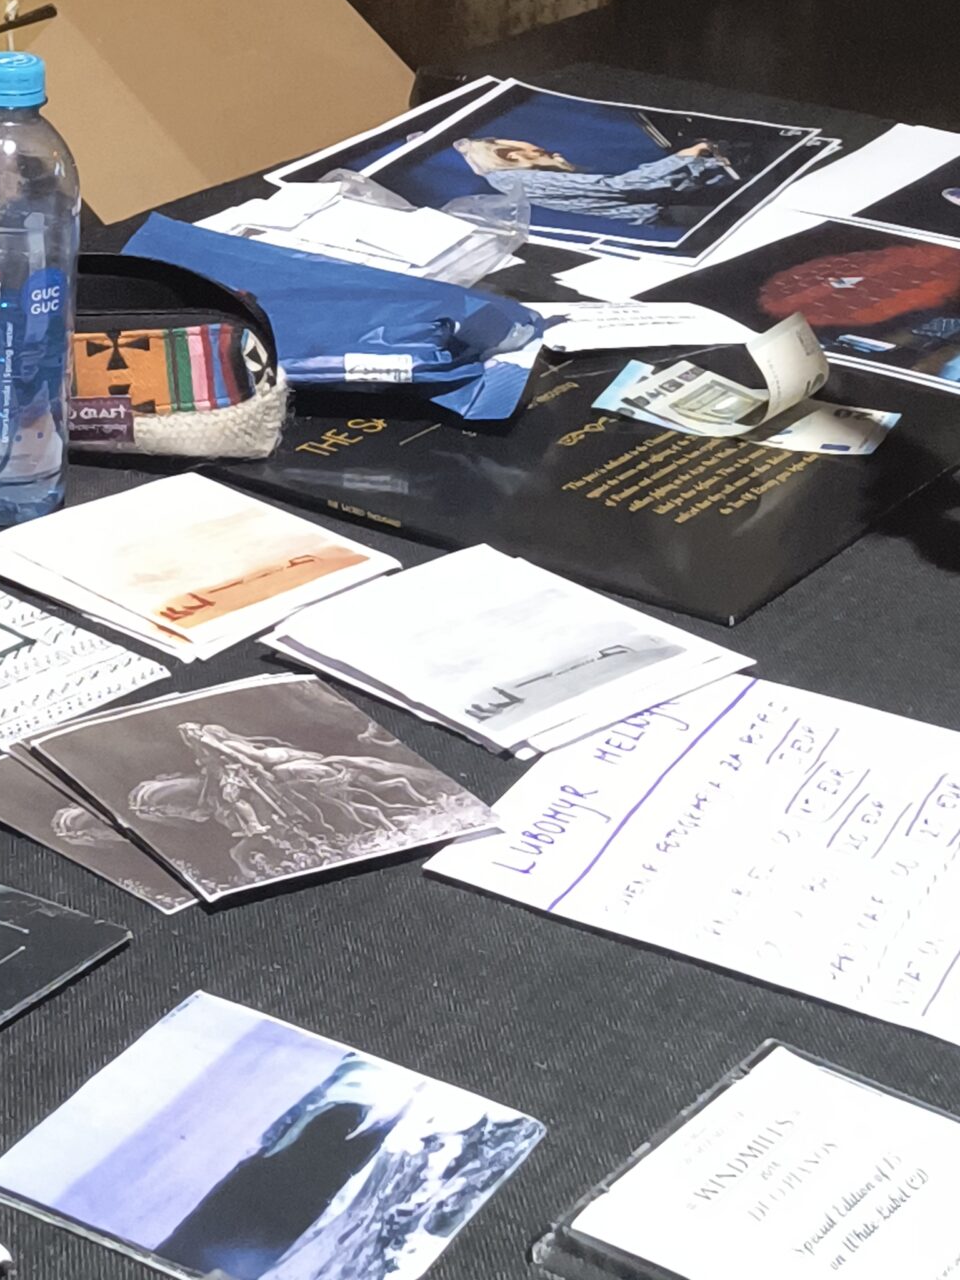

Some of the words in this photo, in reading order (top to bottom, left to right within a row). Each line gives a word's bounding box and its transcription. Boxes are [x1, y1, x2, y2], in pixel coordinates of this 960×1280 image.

[30, 286, 60, 301] GUC
[30, 300, 60, 315] GUC
[80, 404, 128, 419] CRAFT
[296, 428, 363, 457] THE
